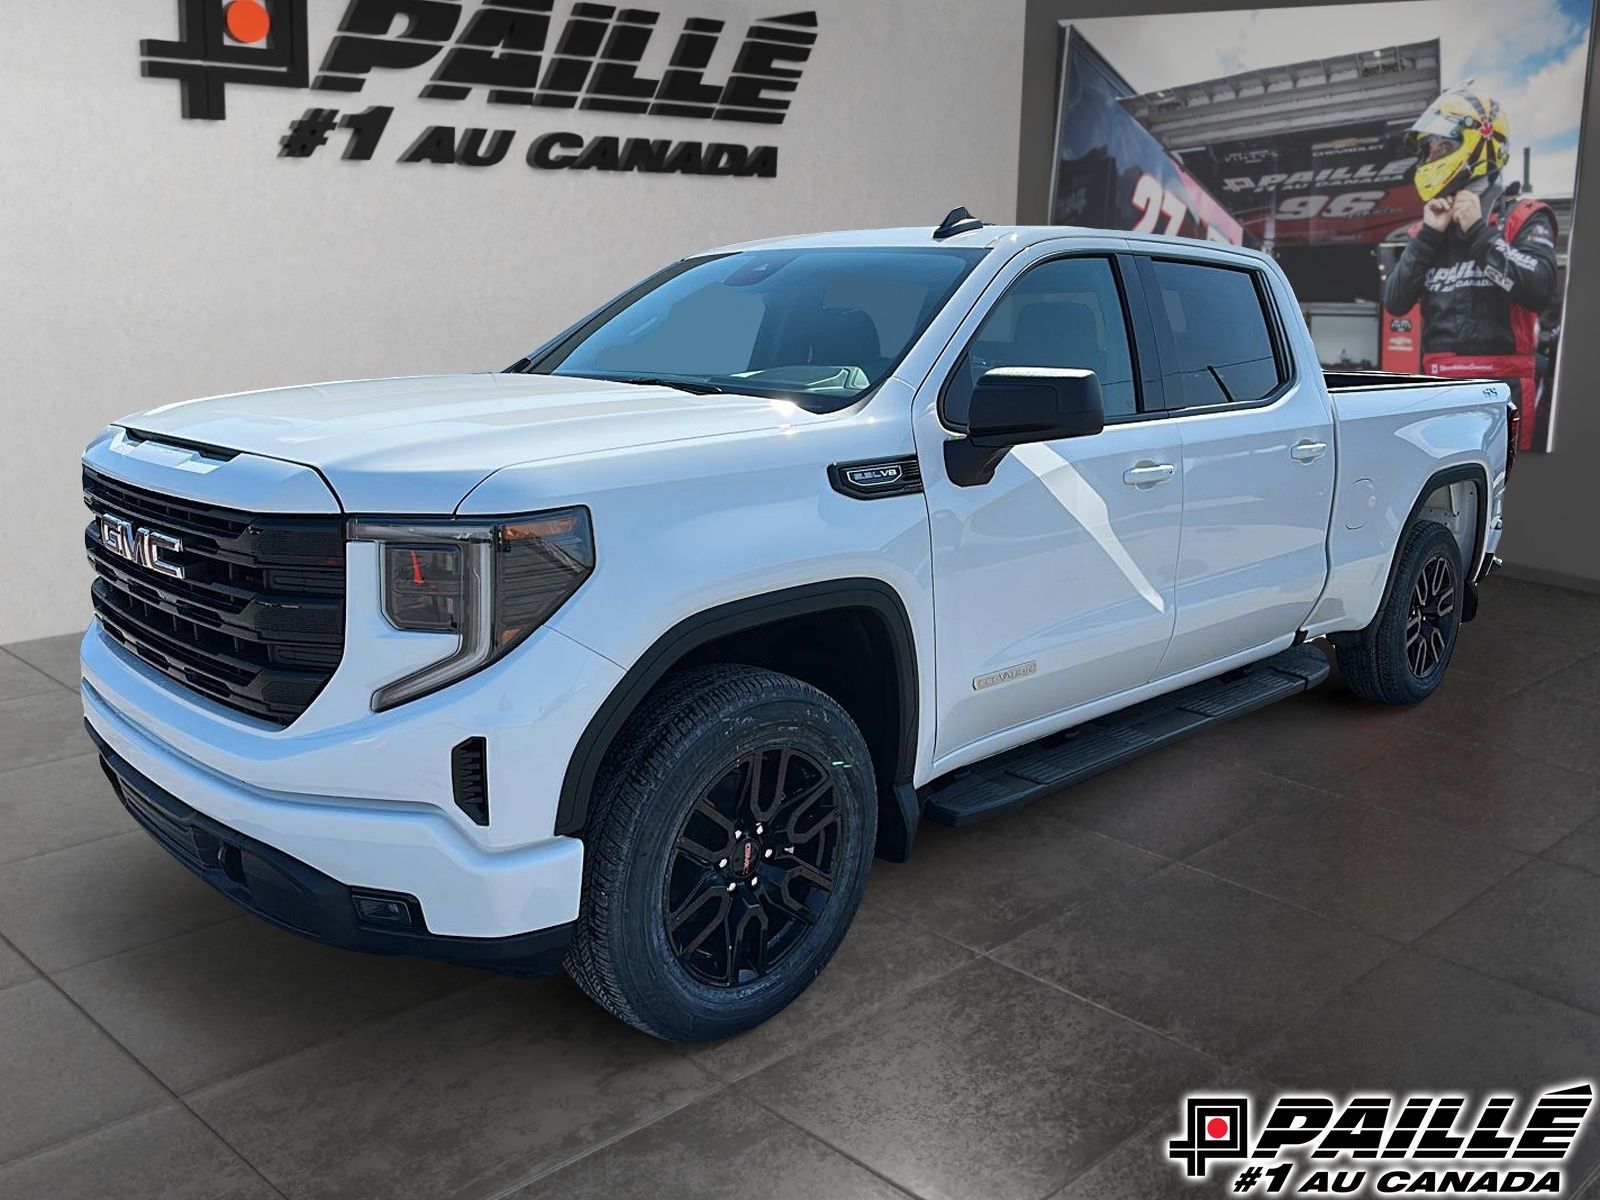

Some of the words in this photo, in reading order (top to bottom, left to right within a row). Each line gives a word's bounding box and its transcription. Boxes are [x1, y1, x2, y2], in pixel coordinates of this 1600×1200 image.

[278, 107, 394, 160] #1
[397, 126, 516, 166] AU
[526, 132, 778, 178] CANADA
[1275, 190, 1386, 220] 96
[101, 512, 186, 579] GMC
